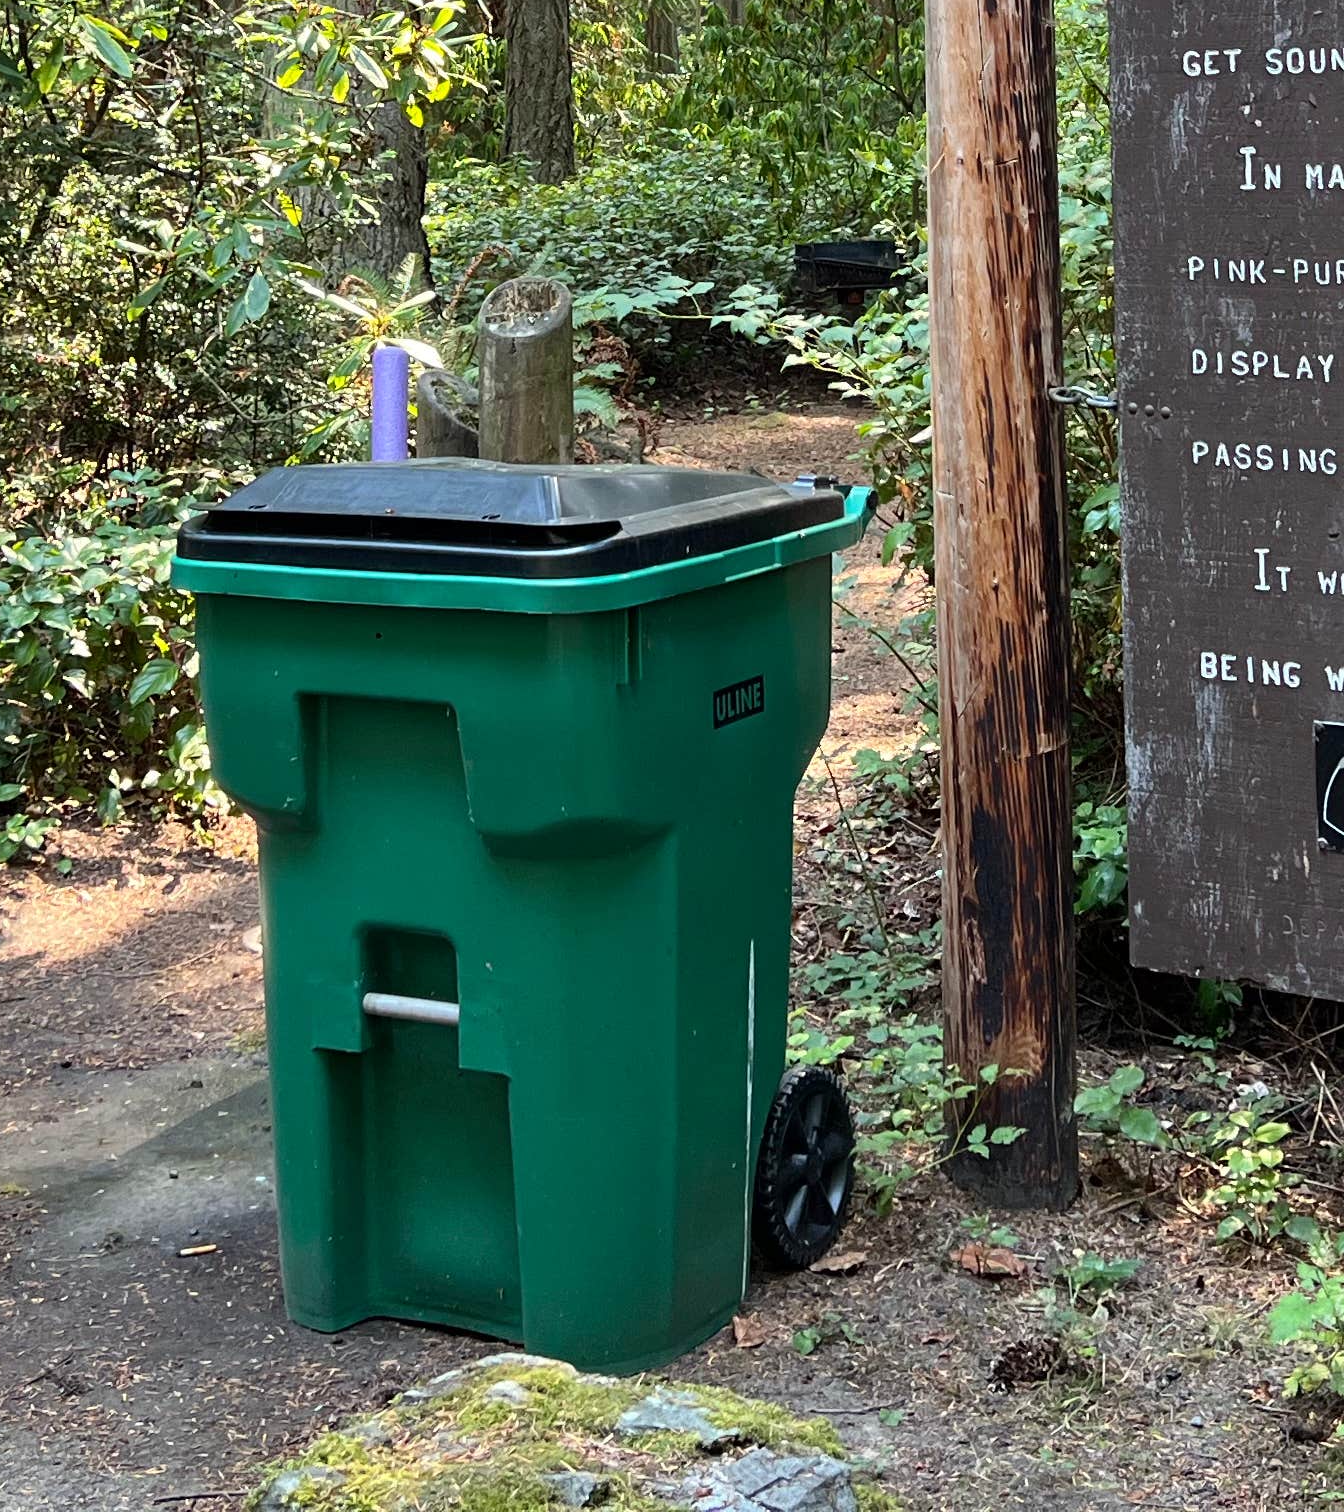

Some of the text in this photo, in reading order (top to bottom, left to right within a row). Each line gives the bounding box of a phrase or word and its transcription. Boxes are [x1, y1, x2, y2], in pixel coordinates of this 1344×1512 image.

[1182, 48, 1242, 77] GET
[1239, 146, 1281, 190] IN
[1192, 348, 1334, 383] DISPLAY
[1192, 441, 1337, 475] PASSING
[1253, 548, 1291, 592] IT
[1200, 651, 1301, 688] BEING
[716, 682, 761, 721] ULINE
